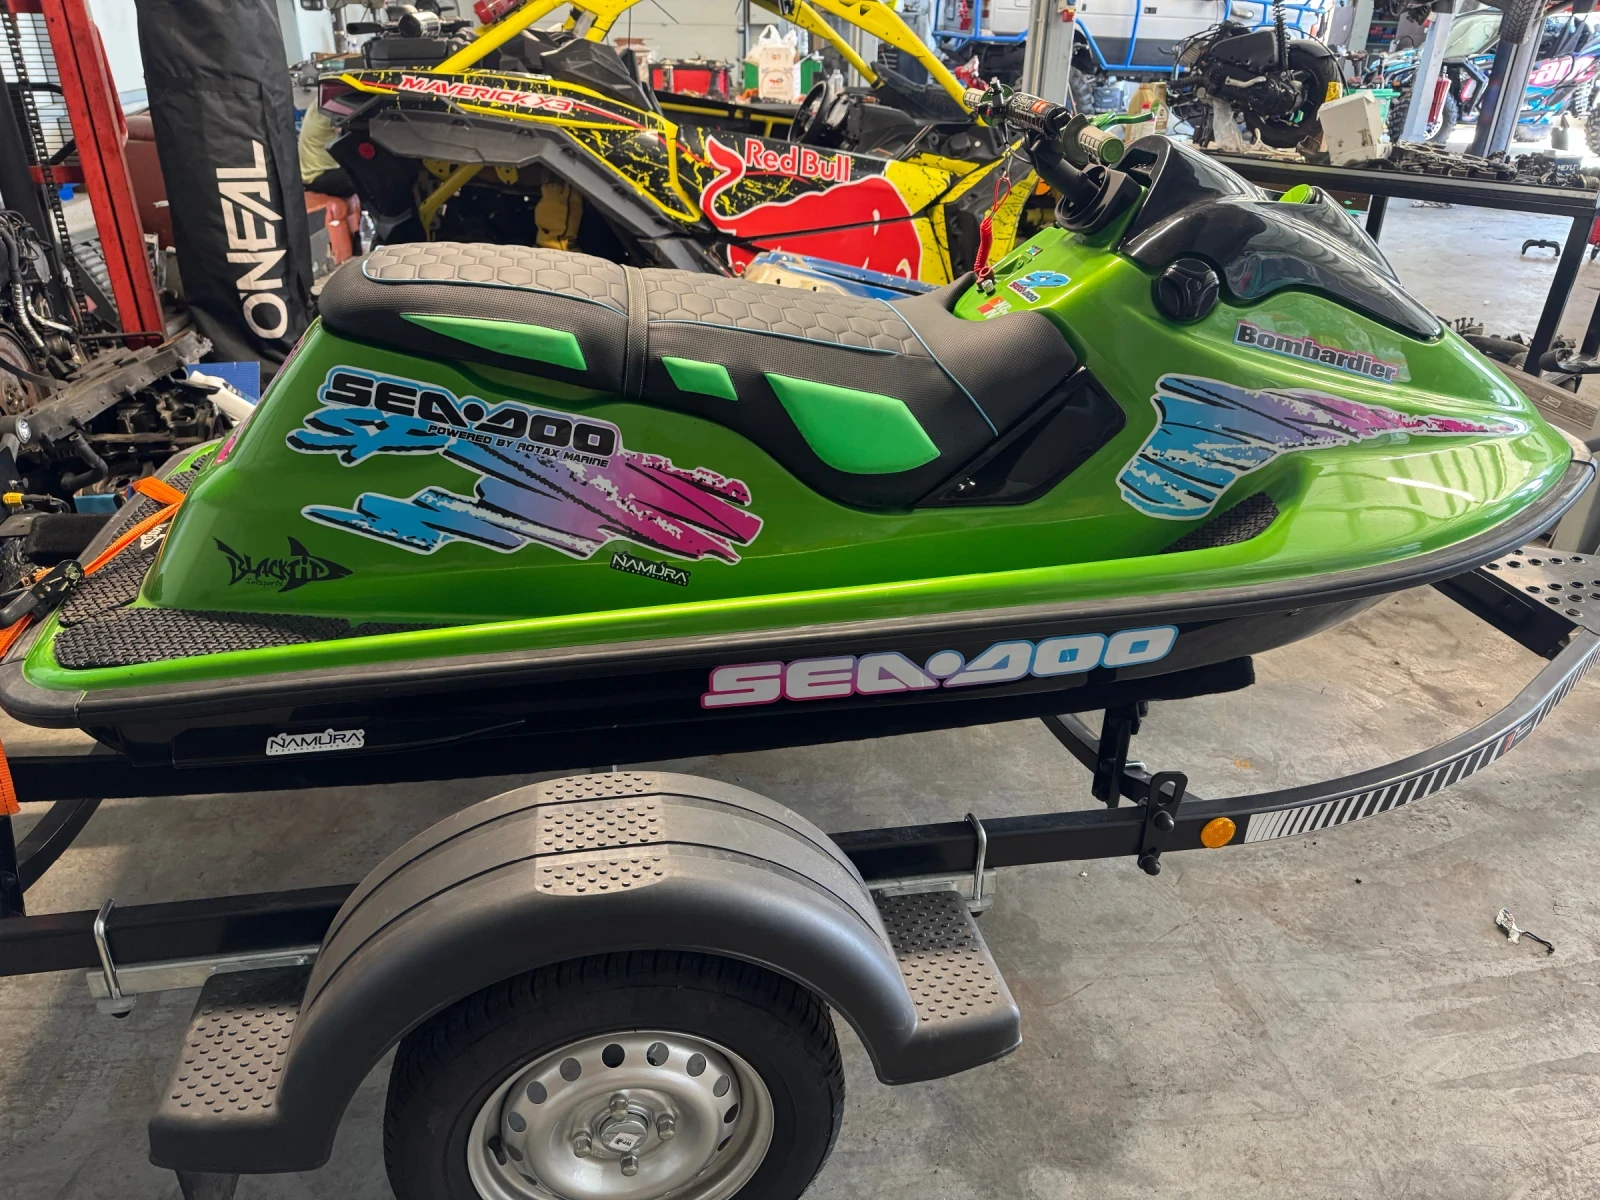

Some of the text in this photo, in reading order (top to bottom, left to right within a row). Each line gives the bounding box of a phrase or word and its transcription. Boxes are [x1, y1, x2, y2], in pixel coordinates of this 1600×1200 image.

[399, 75, 574, 113] MAVERICK X3
[745, 137, 851, 184] Red Bull
[1235, 322, 1398, 382] Bombardier
[427, 424, 611, 469] POWERED BY ROTAX MARINE
[612, 553, 688, 583] NAMURA
[269, 731, 362, 750] NAMURA
